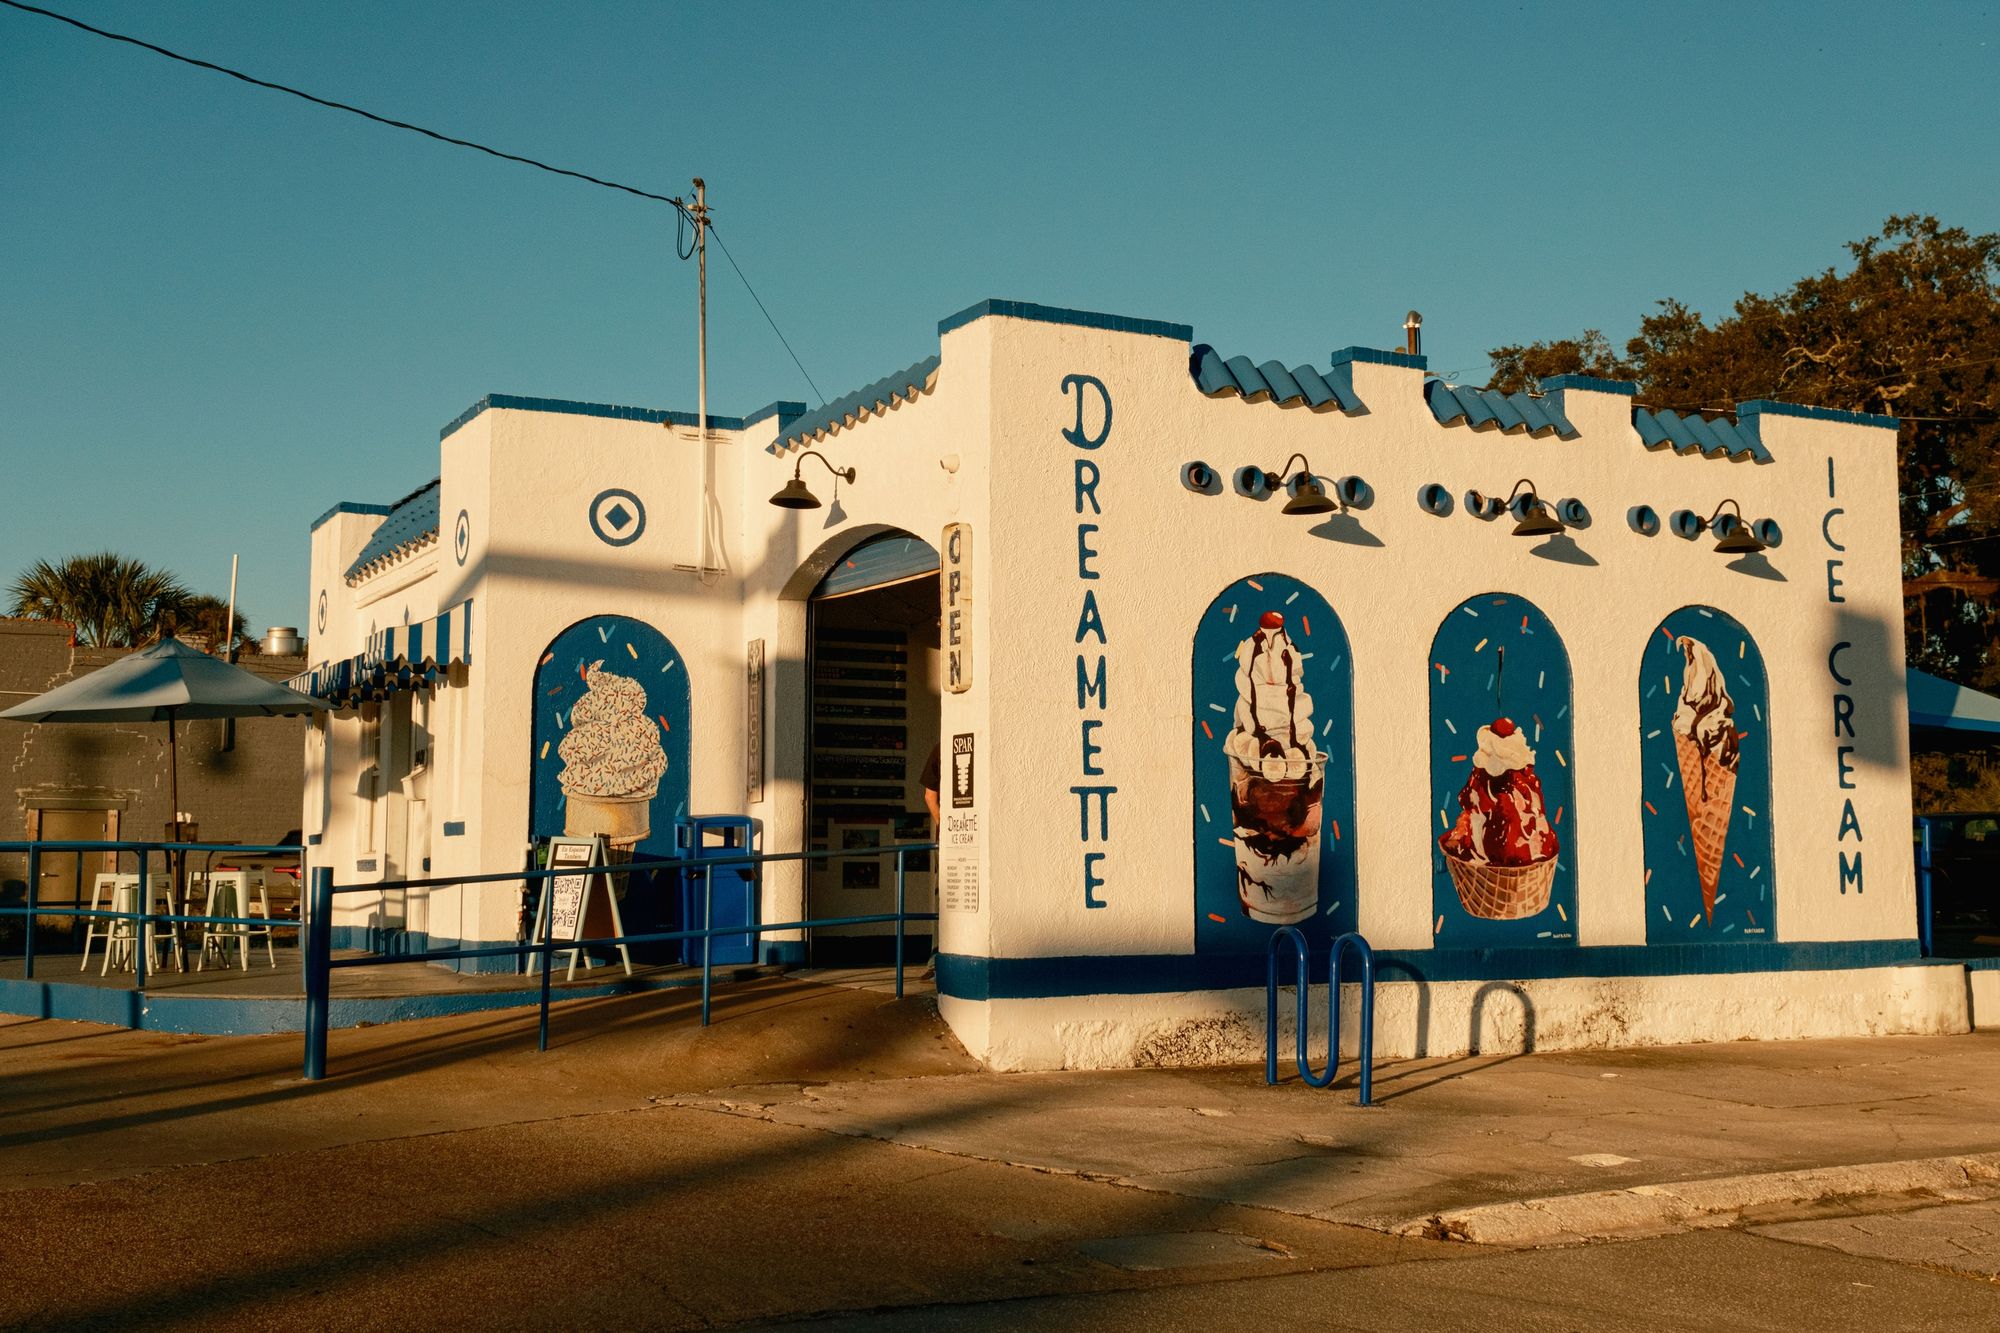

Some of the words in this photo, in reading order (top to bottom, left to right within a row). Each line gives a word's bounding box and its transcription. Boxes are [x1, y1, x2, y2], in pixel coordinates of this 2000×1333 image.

[1822, 456, 1846, 603] ICE
[948, 529, 961, 686] OPEN
[1061, 374, 1118, 909] DREAMETTE
[953, 736, 973, 754] SPAR
[1828, 641, 1863, 895] CREAM
[947, 813, 978, 832] DREAMETTE
[951, 834, 959, 844] ICE
[959, 833, 974, 844] CREAM
